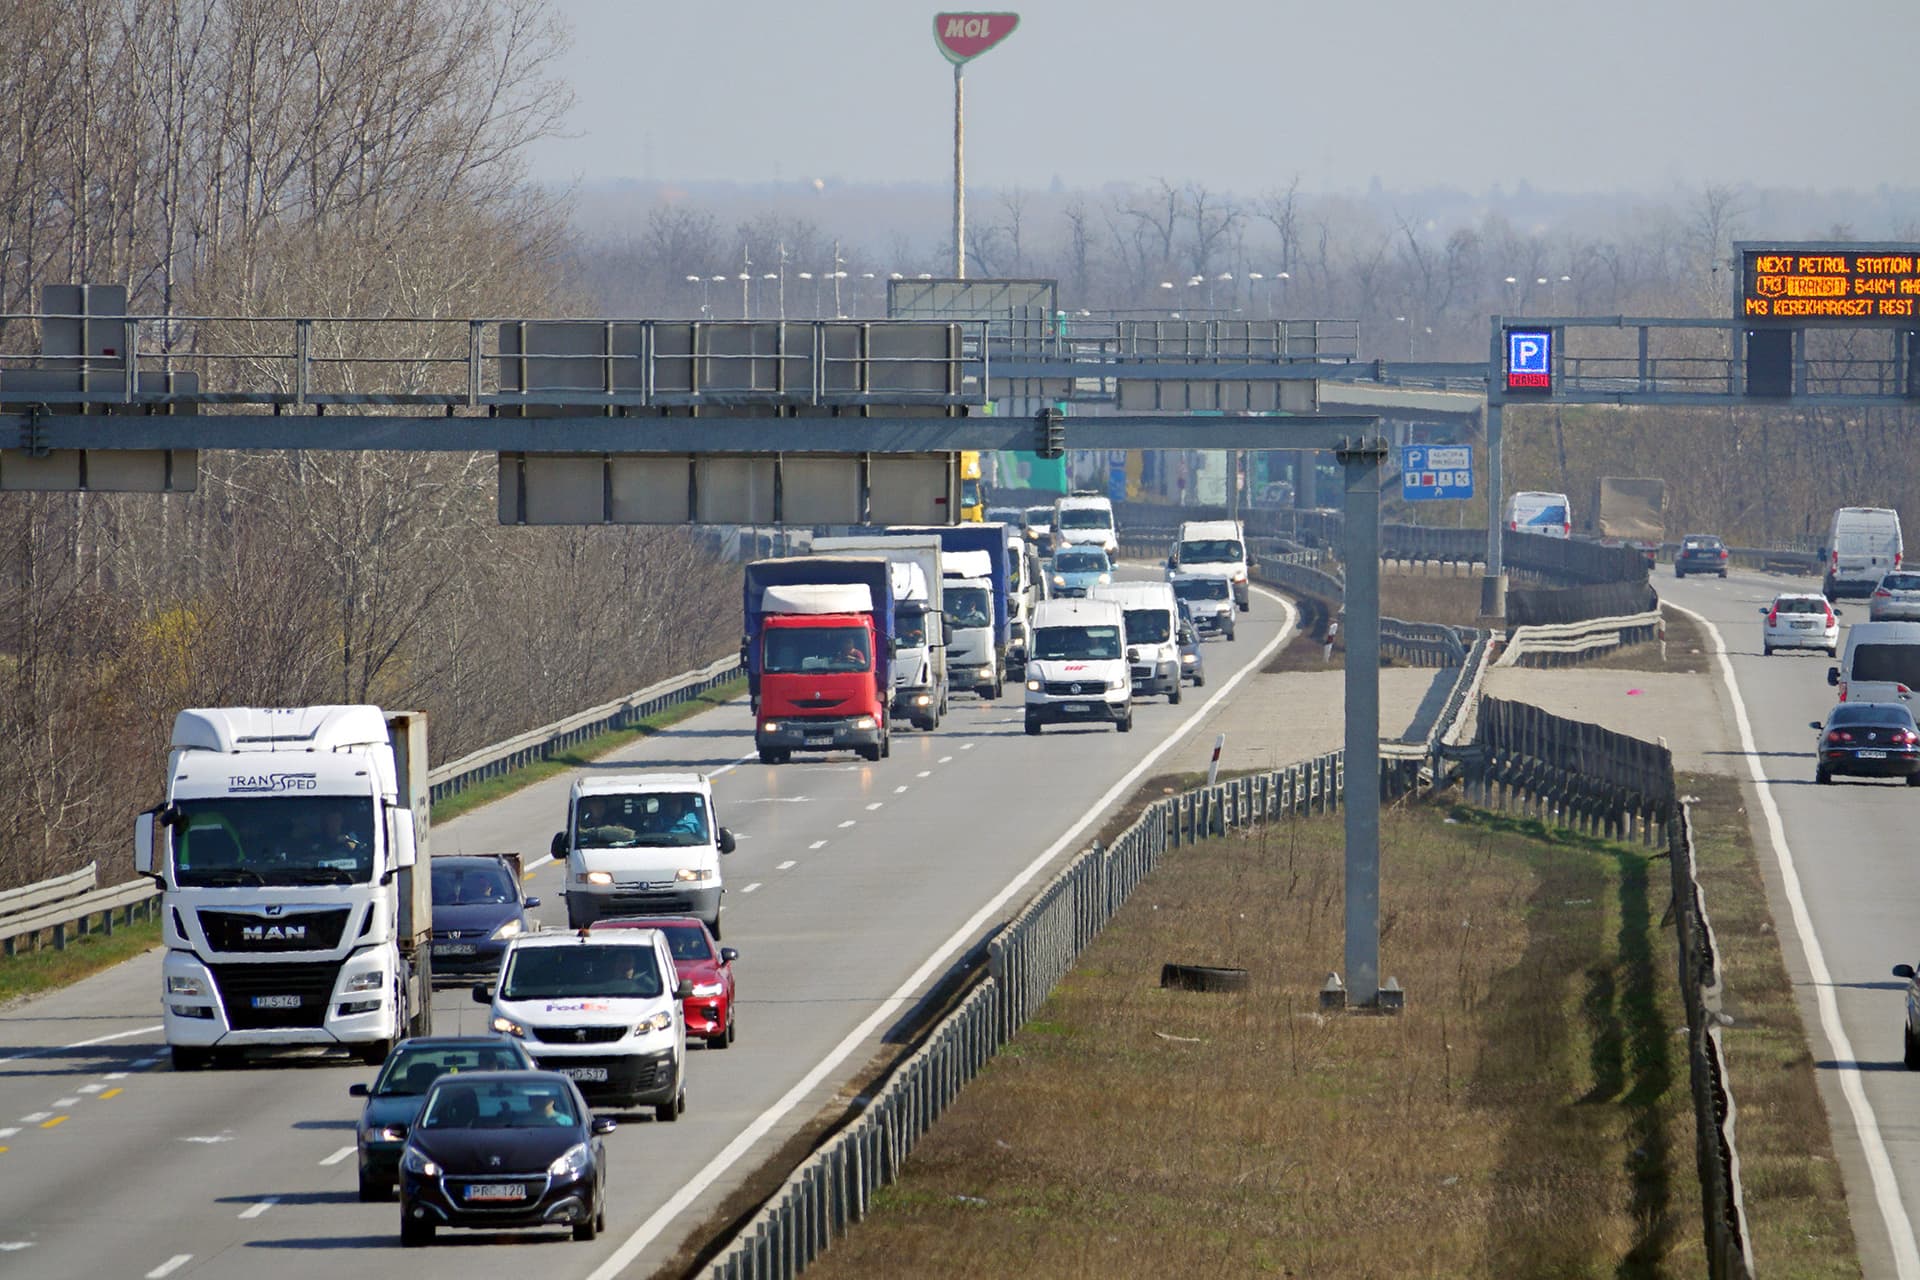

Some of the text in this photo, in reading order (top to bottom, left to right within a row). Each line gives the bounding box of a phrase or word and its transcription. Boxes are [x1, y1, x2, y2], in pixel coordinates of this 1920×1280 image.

[944, 18, 990, 38] MOL
[1757, 256, 1794, 273] NEXT
[1799, 257, 1850, 273] PETROL
[1856, 257, 1912, 274] STATION
[1763, 278, 1782, 291] M3
[1854, 278, 1895, 294] 54KM
[1746, 298, 1913, 315] M3 KEREKHARASZT REST
[1520, 341, 1539, 366] P
[1511, 374, 1547, 385] TRANSIT
[243, 926, 306, 940] MAN
